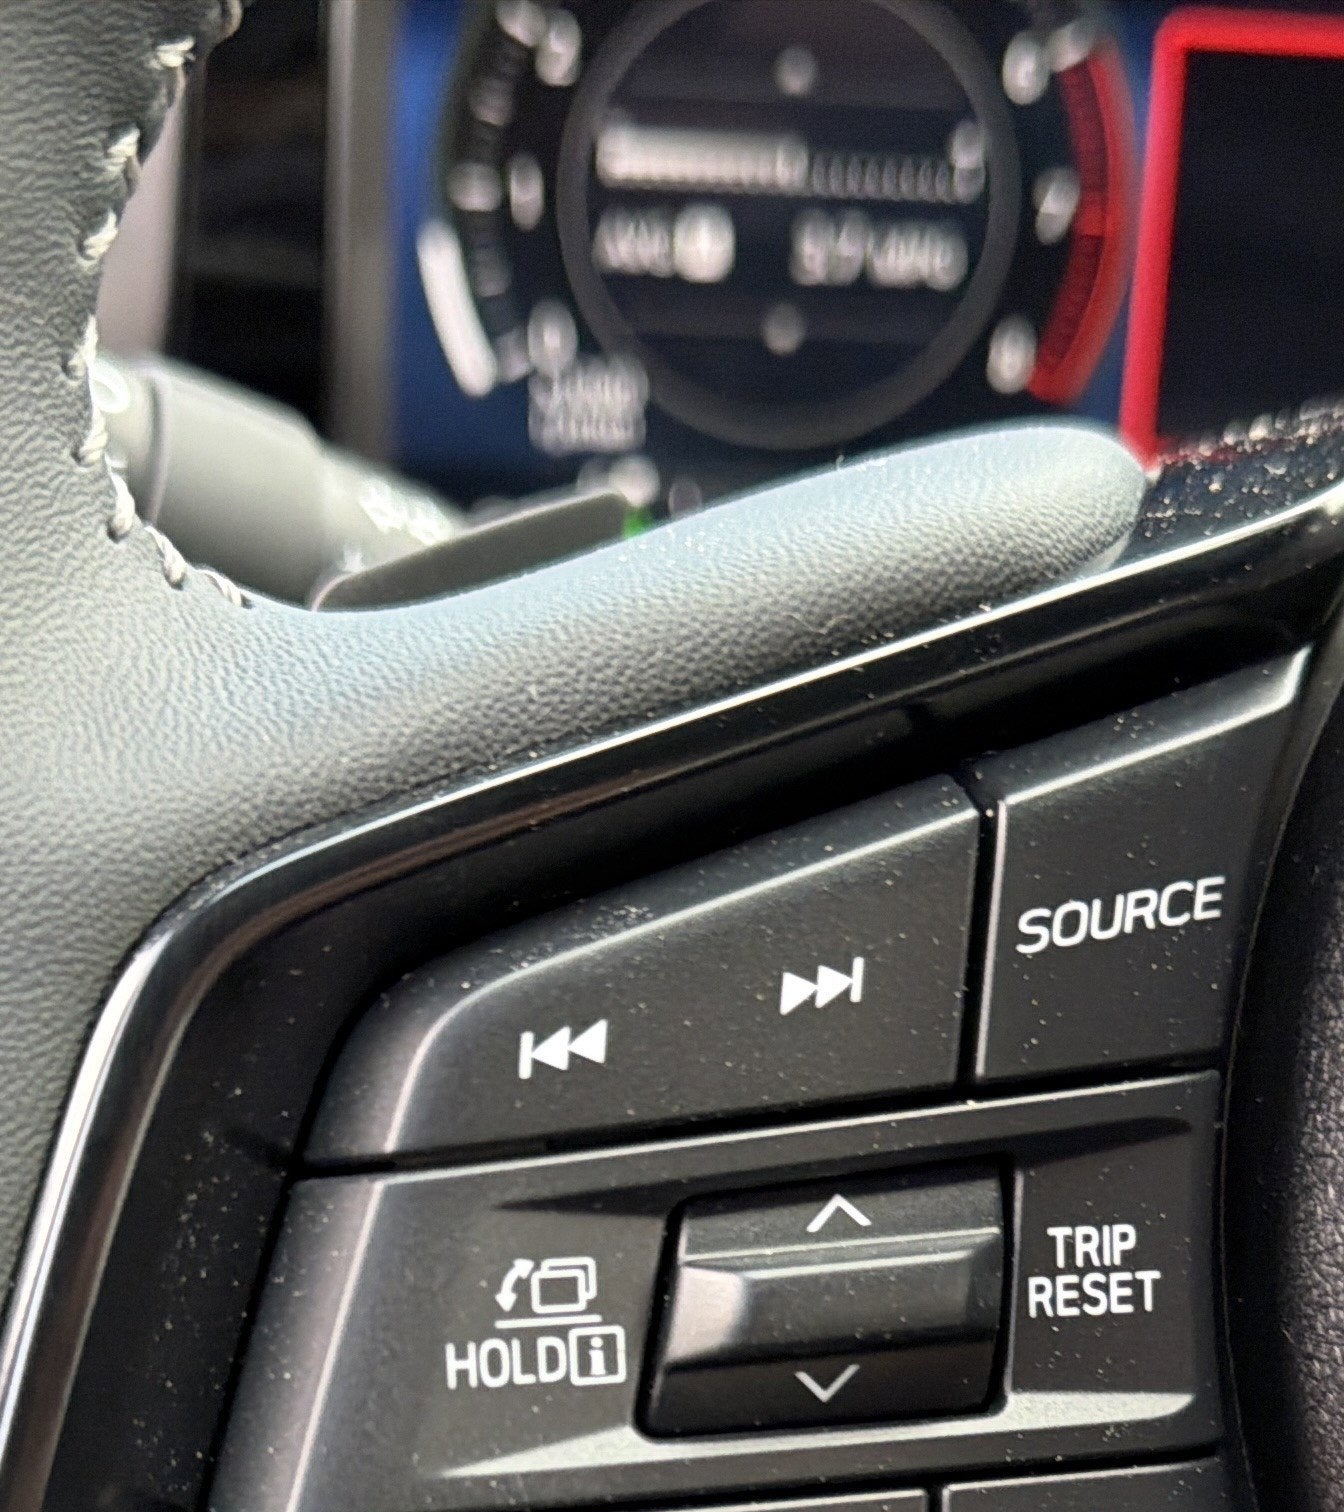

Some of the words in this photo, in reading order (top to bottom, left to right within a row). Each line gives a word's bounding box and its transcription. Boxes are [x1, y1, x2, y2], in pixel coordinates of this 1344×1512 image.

[1016, 877, 1224, 953] SOURCE
[1047, 1224, 1137, 1268] TRIP
[1028, 1270, 1161, 1317] RESET
[445, 1336, 568, 1390] HOLD
